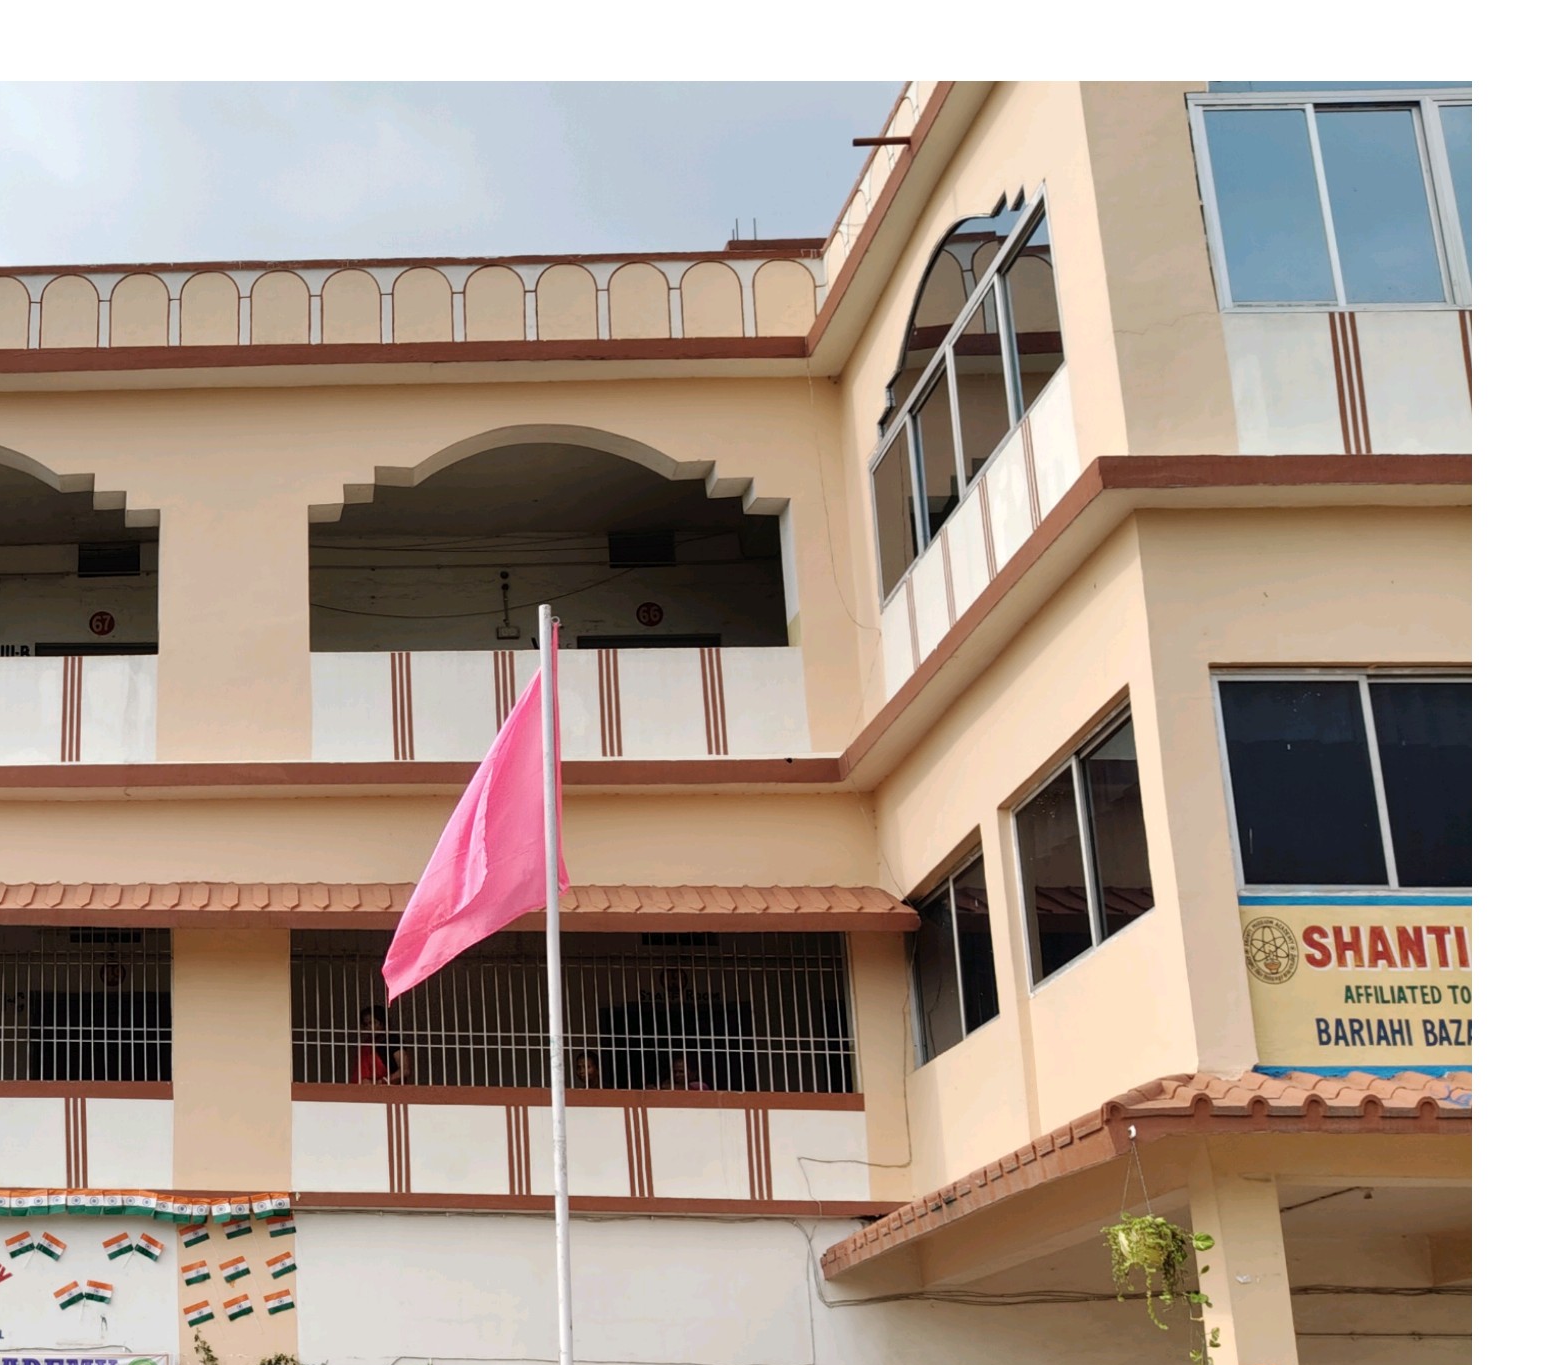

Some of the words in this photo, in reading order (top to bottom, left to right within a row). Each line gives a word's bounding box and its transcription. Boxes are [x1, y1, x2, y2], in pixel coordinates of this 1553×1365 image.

[92, 615, 111, 632] 67
[1302, 925, 1470, 968] SHANTI
[1344, 985, 1442, 1004] AFFILIATED
[1447, 985, 1471, 1004] TO
[1315, 1018, 1413, 1047] BARIAHI
